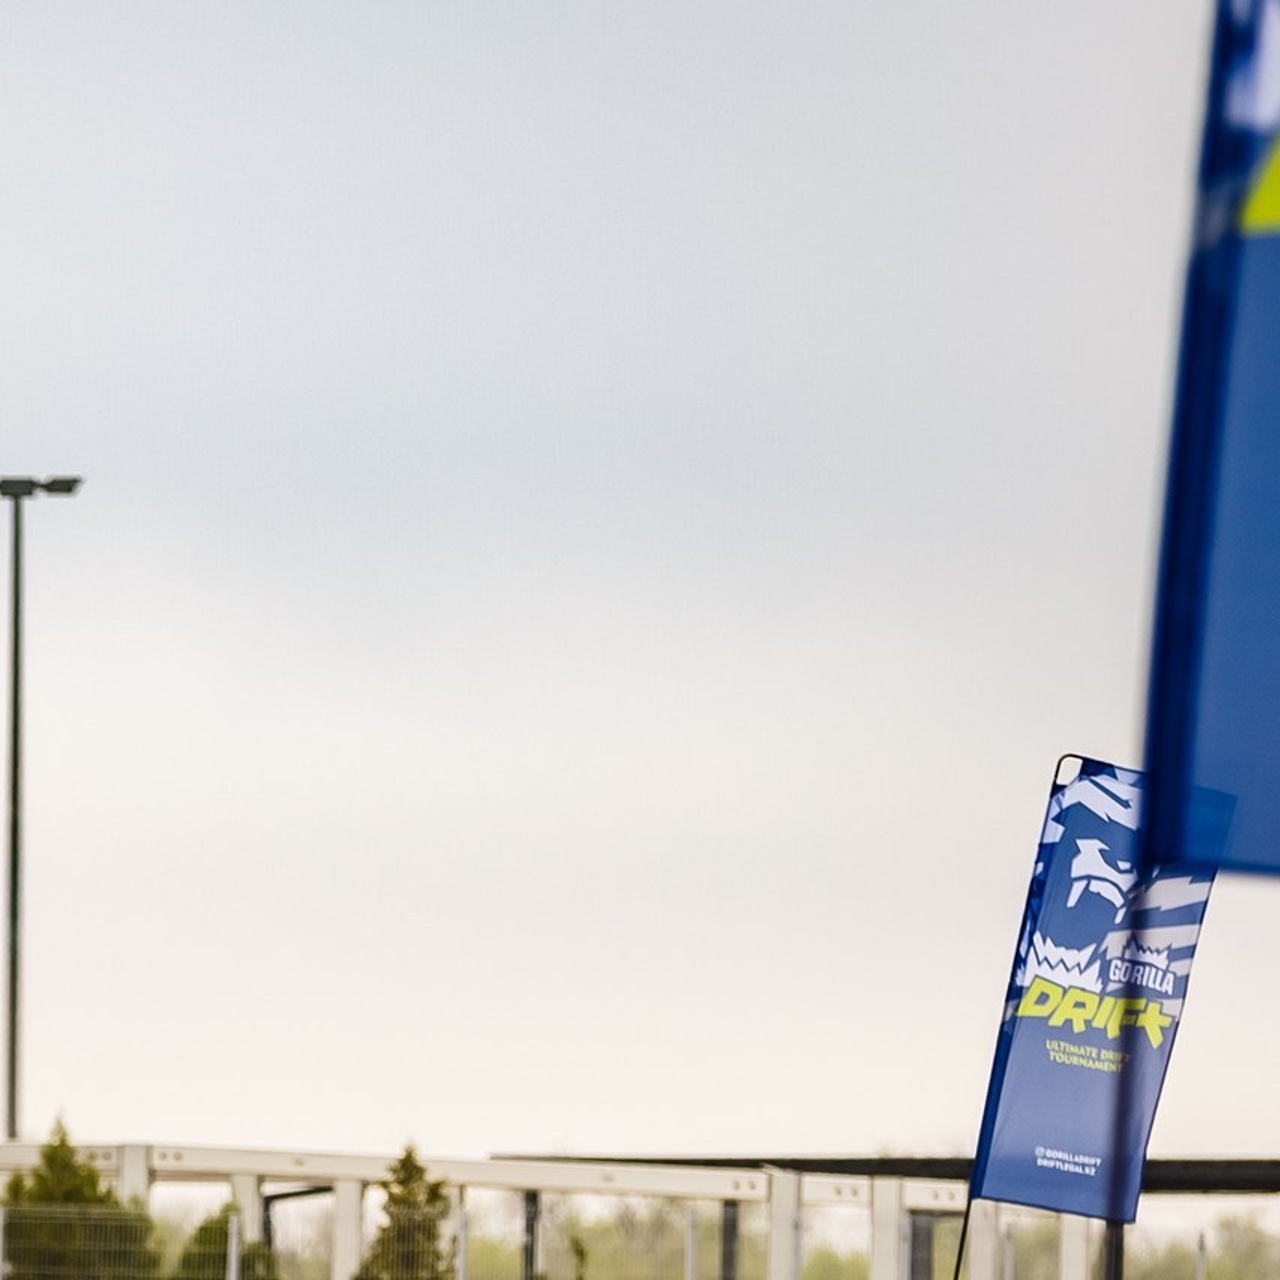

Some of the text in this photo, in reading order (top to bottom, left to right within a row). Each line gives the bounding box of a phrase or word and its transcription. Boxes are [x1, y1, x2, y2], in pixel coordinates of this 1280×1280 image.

[1109, 958, 1175, 995] GORILLA
[1016, 976, 1173, 1050] DRIFT
[1046, 1039, 1098, 1059] ULTIMATE
